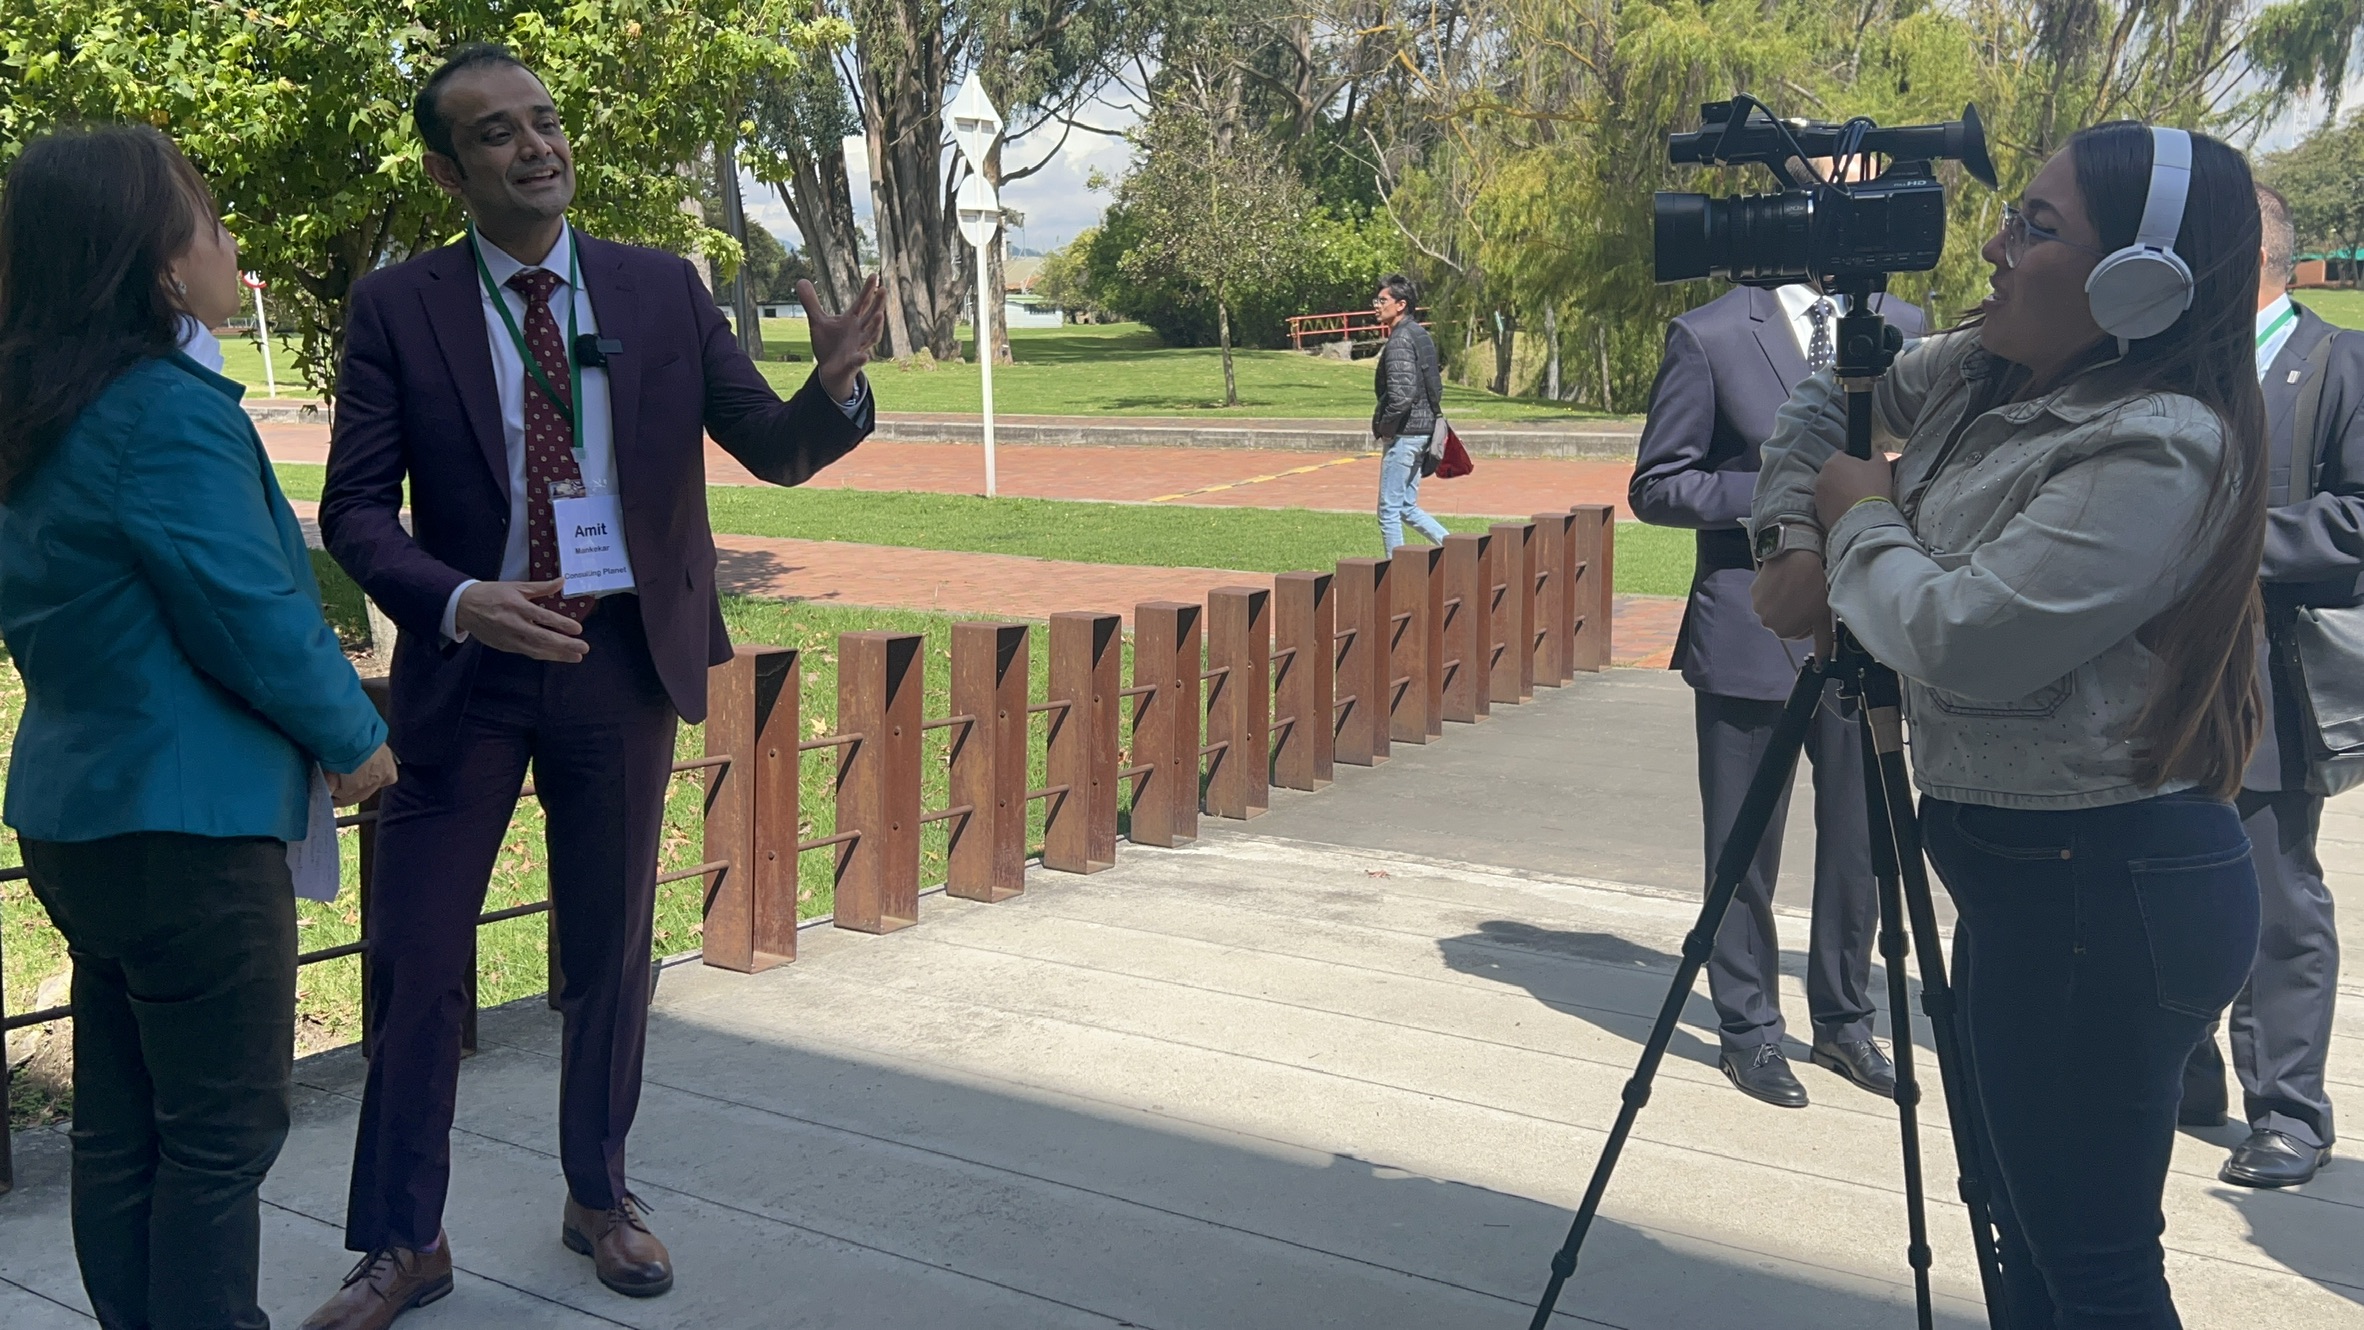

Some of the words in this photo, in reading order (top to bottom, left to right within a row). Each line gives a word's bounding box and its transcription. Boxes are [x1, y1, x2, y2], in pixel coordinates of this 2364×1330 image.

[1907, 179, 1927, 187] HD
[575, 522, 608, 538] Amit
[602, 566, 627, 575] Planet
